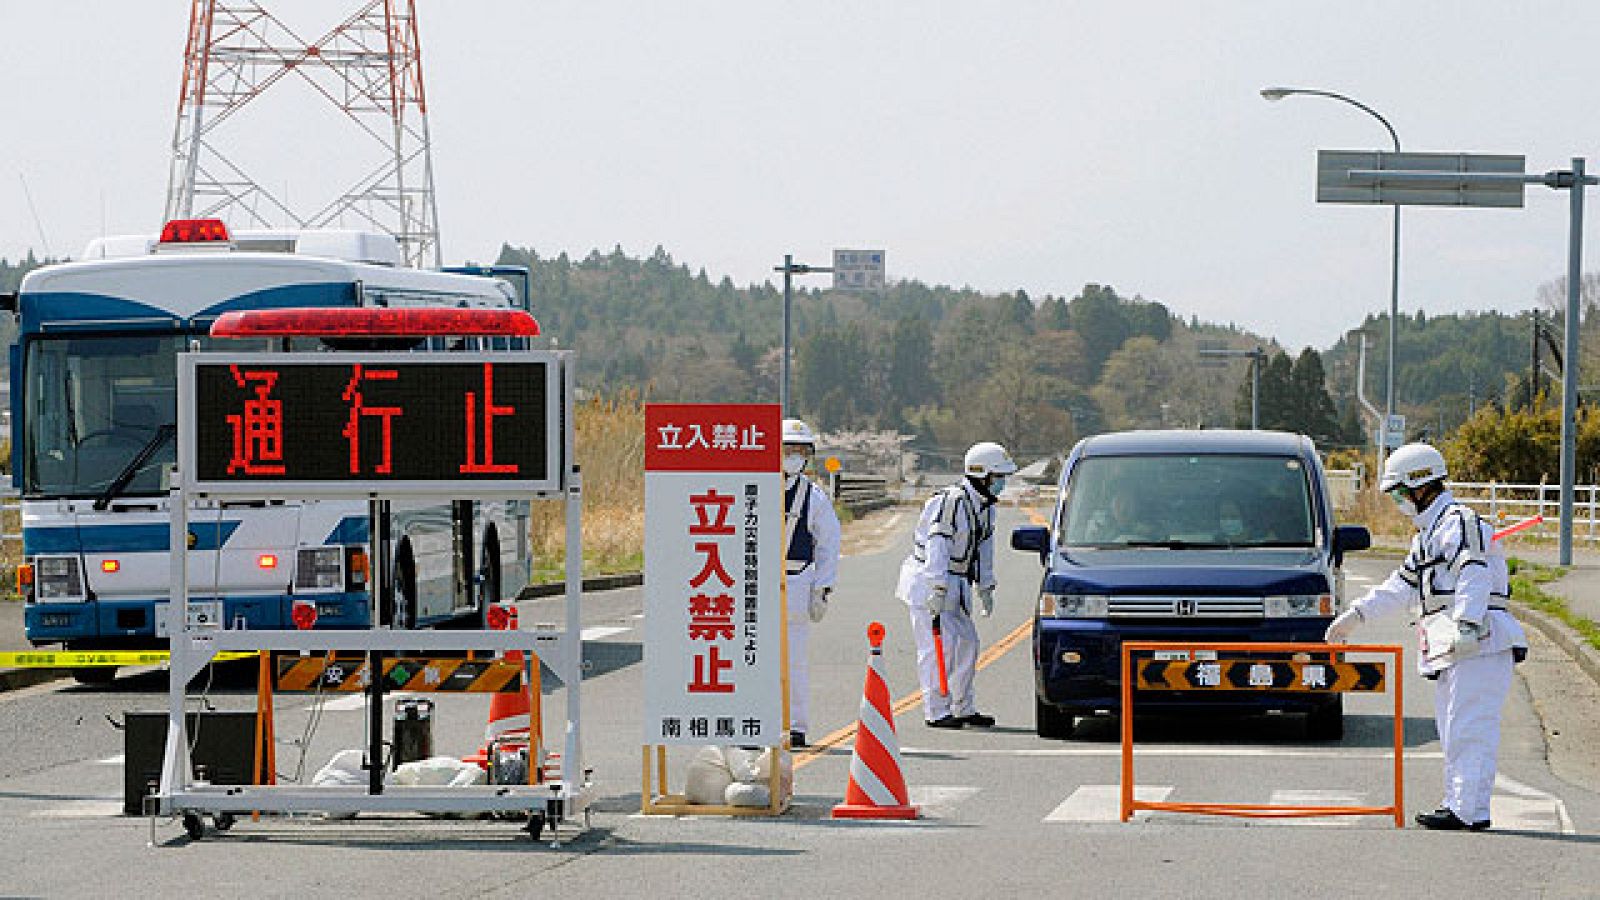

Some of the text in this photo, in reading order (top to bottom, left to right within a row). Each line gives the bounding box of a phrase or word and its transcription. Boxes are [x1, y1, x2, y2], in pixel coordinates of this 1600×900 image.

[227, 363, 518, 474] 通行止
[656, 423, 766, 451] 立入禁止
[688, 489, 736, 694] 立入禁止
[661, 717, 762, 738] 南相馬市
